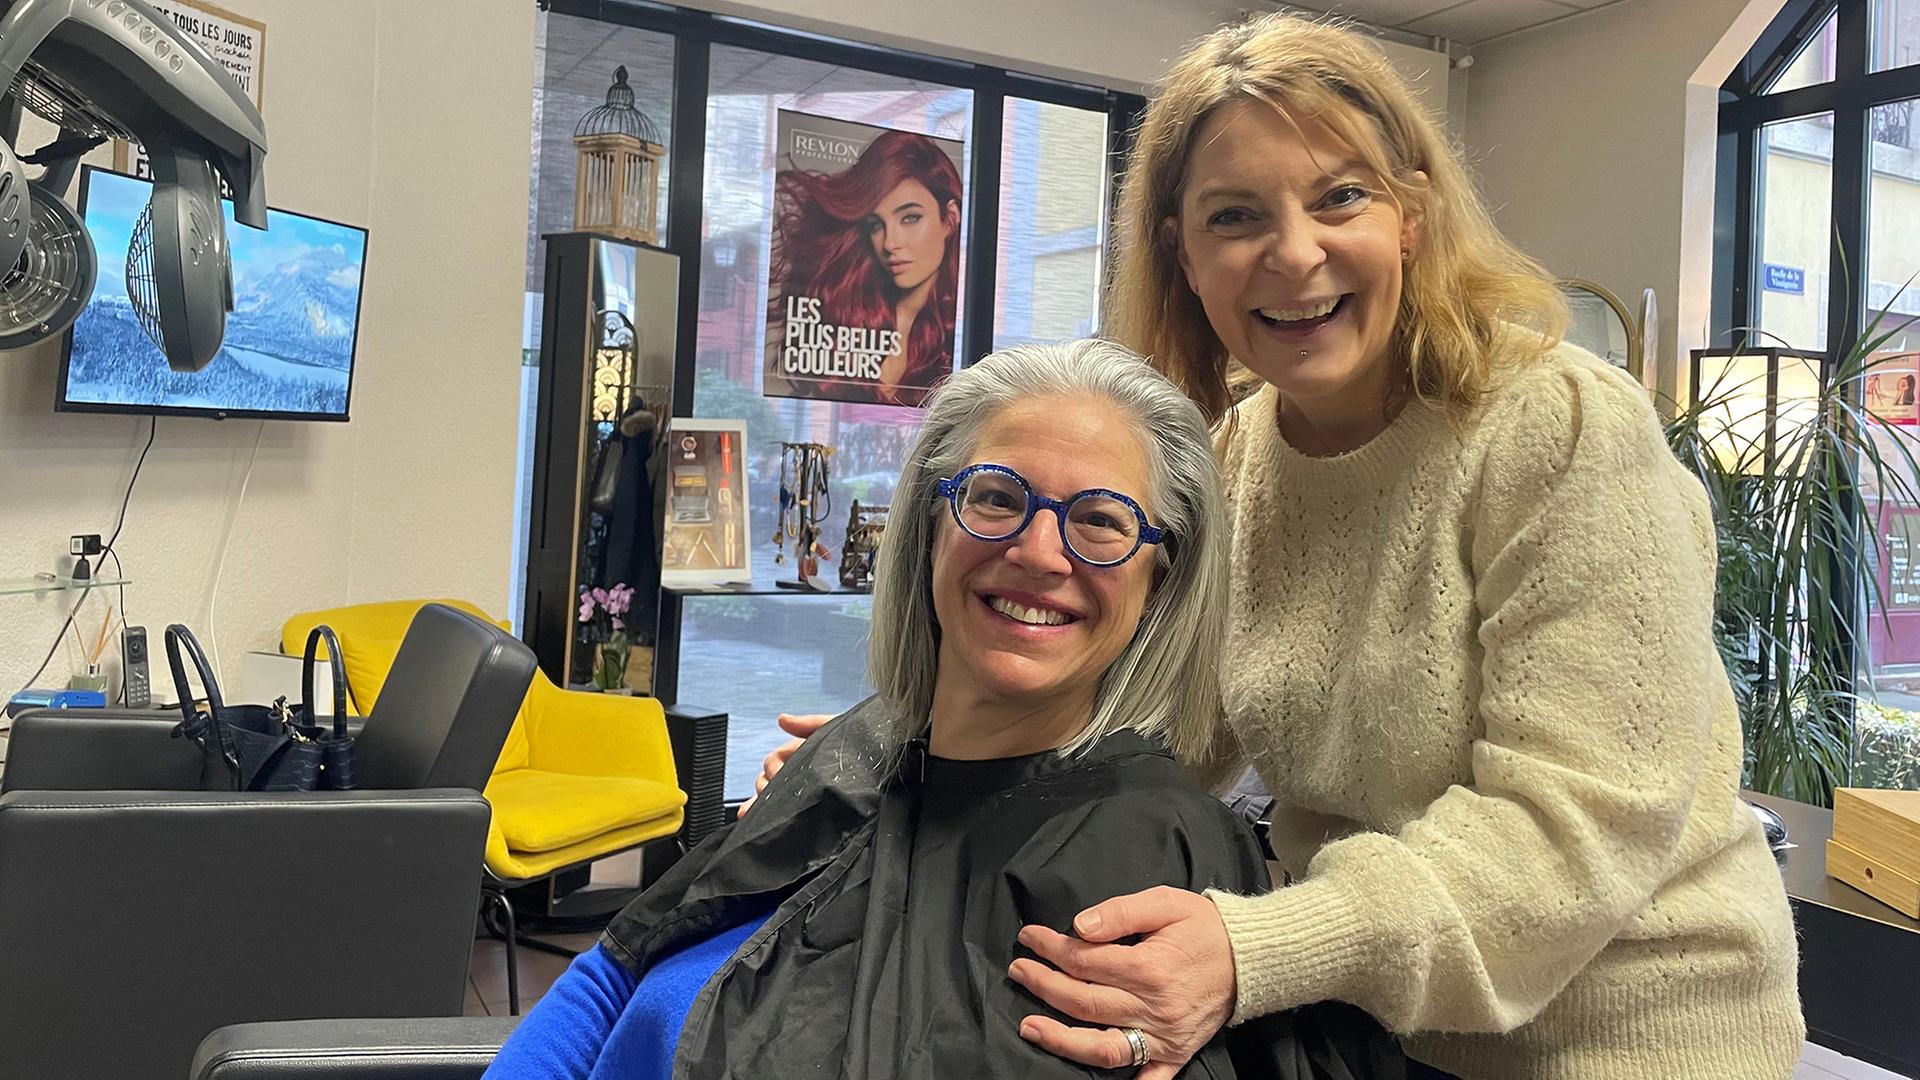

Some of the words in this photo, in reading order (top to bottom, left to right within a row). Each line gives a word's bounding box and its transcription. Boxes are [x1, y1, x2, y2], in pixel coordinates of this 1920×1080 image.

[173, 12, 199, 35] TOUS
[202, 22, 220, 40] LES
[223, 29, 252, 50] JOURS
[795, 135, 860, 158] REVLON
[786, 295, 821, 325] LES
[785, 322, 835, 351] PLUS
[837, 325, 902, 357] BELLES
[784, 346, 882, 379] COULEURS
